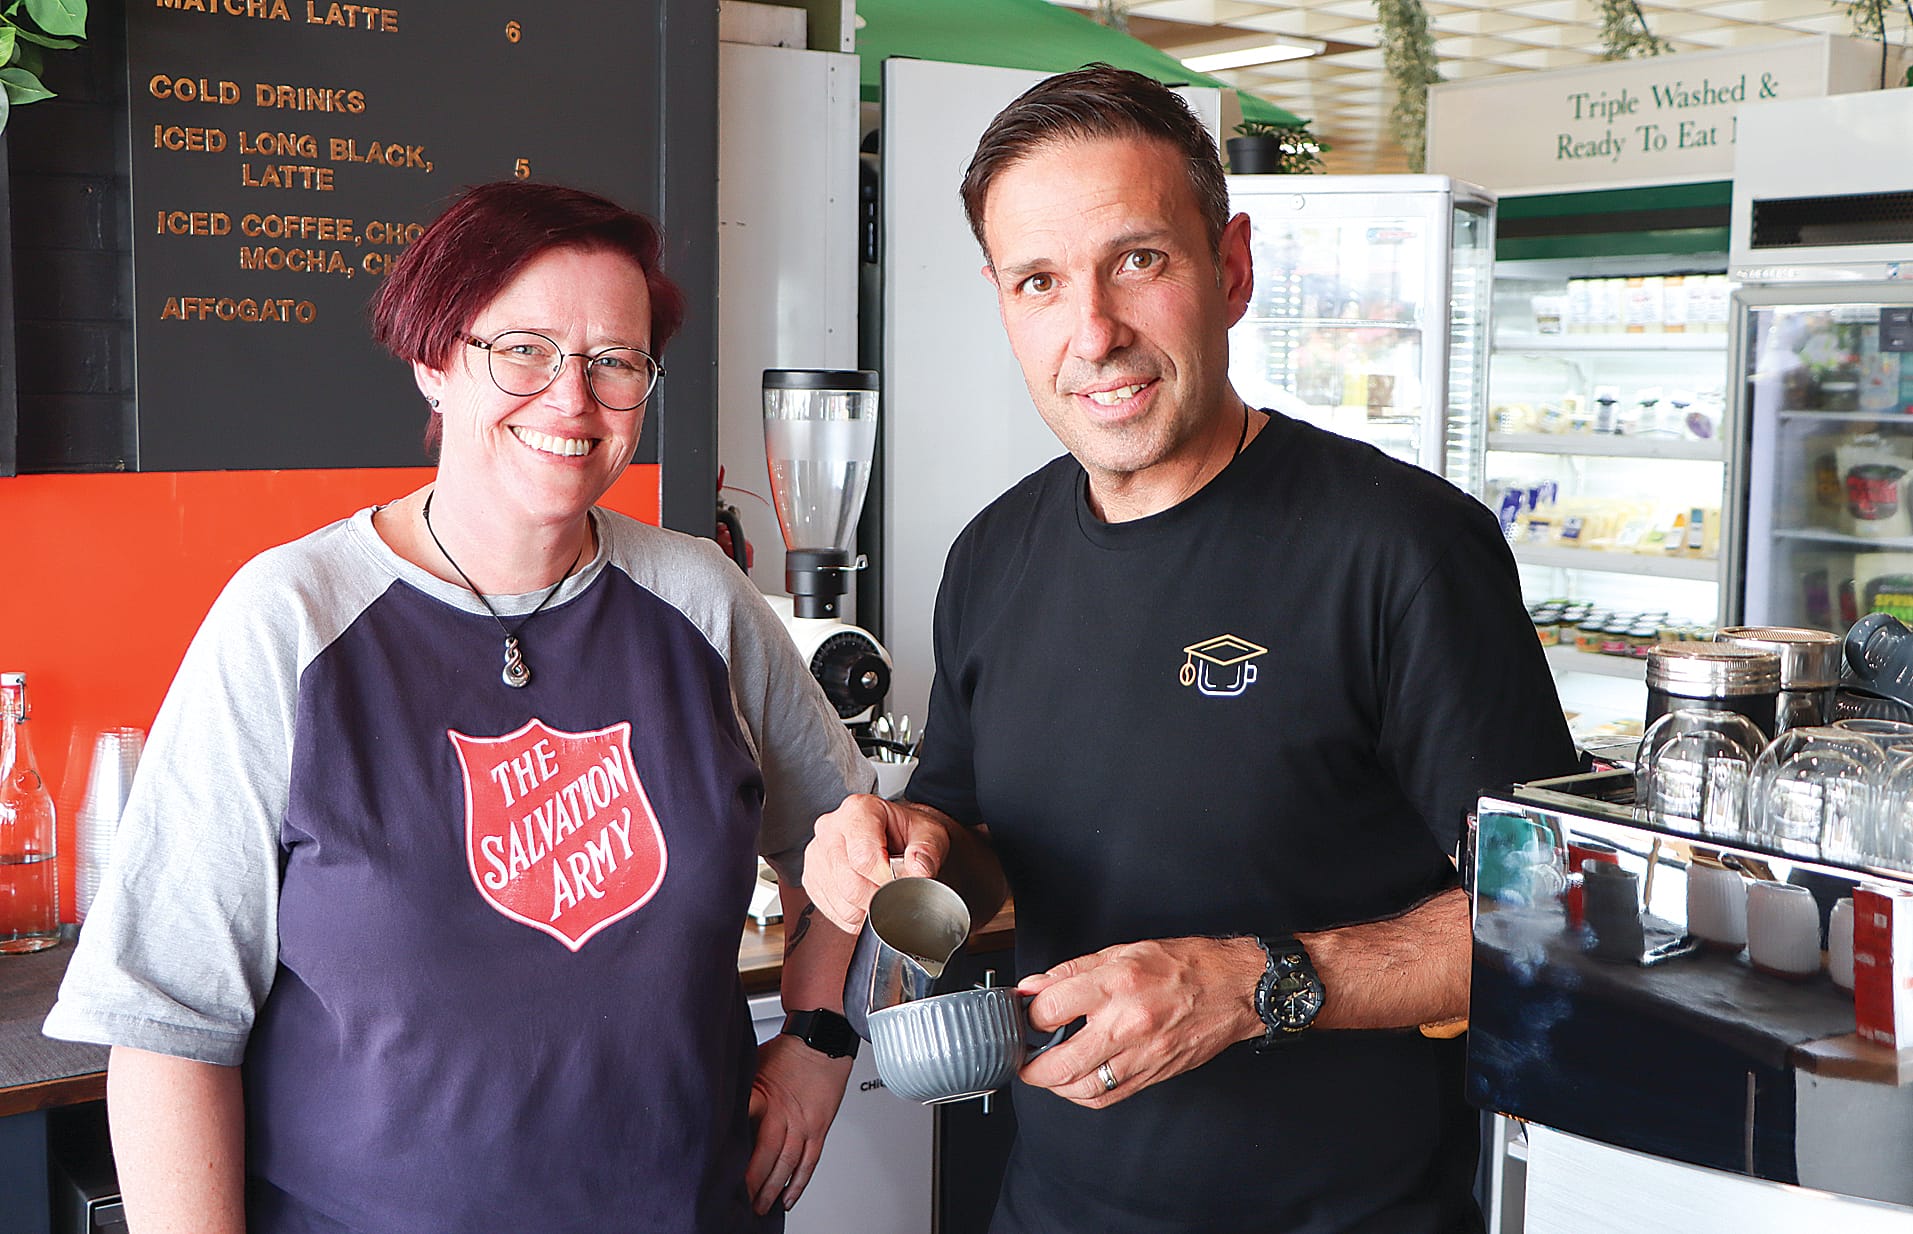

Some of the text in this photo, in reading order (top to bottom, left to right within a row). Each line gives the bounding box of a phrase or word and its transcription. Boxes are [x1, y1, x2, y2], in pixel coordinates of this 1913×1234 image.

[155, 0, 399, 33] ATCHA LATTE
[505, 20, 522, 44] 6
[149, 74, 366, 114] COLD DRINKS
[1567, 71, 1779, 124] Triple Washed &
[154, 125, 434, 173] ICED LONG BLACK,
[1557, 128, 1626, 163] Ready
[1635, 123, 1668, 152] To
[1678, 120, 1717, 149] Eat
[242, 163, 335, 191] LATTE
[514, 158, 531, 180] 5
[157, 211, 232, 236] ICED
[240, 246, 355, 279] MOCHA,
[160, 297, 317, 324] AFFOGATO
[490, 738, 559, 808] THE
[480, 745, 630, 890] SALVATION
[550, 806, 635, 922] ARMY
